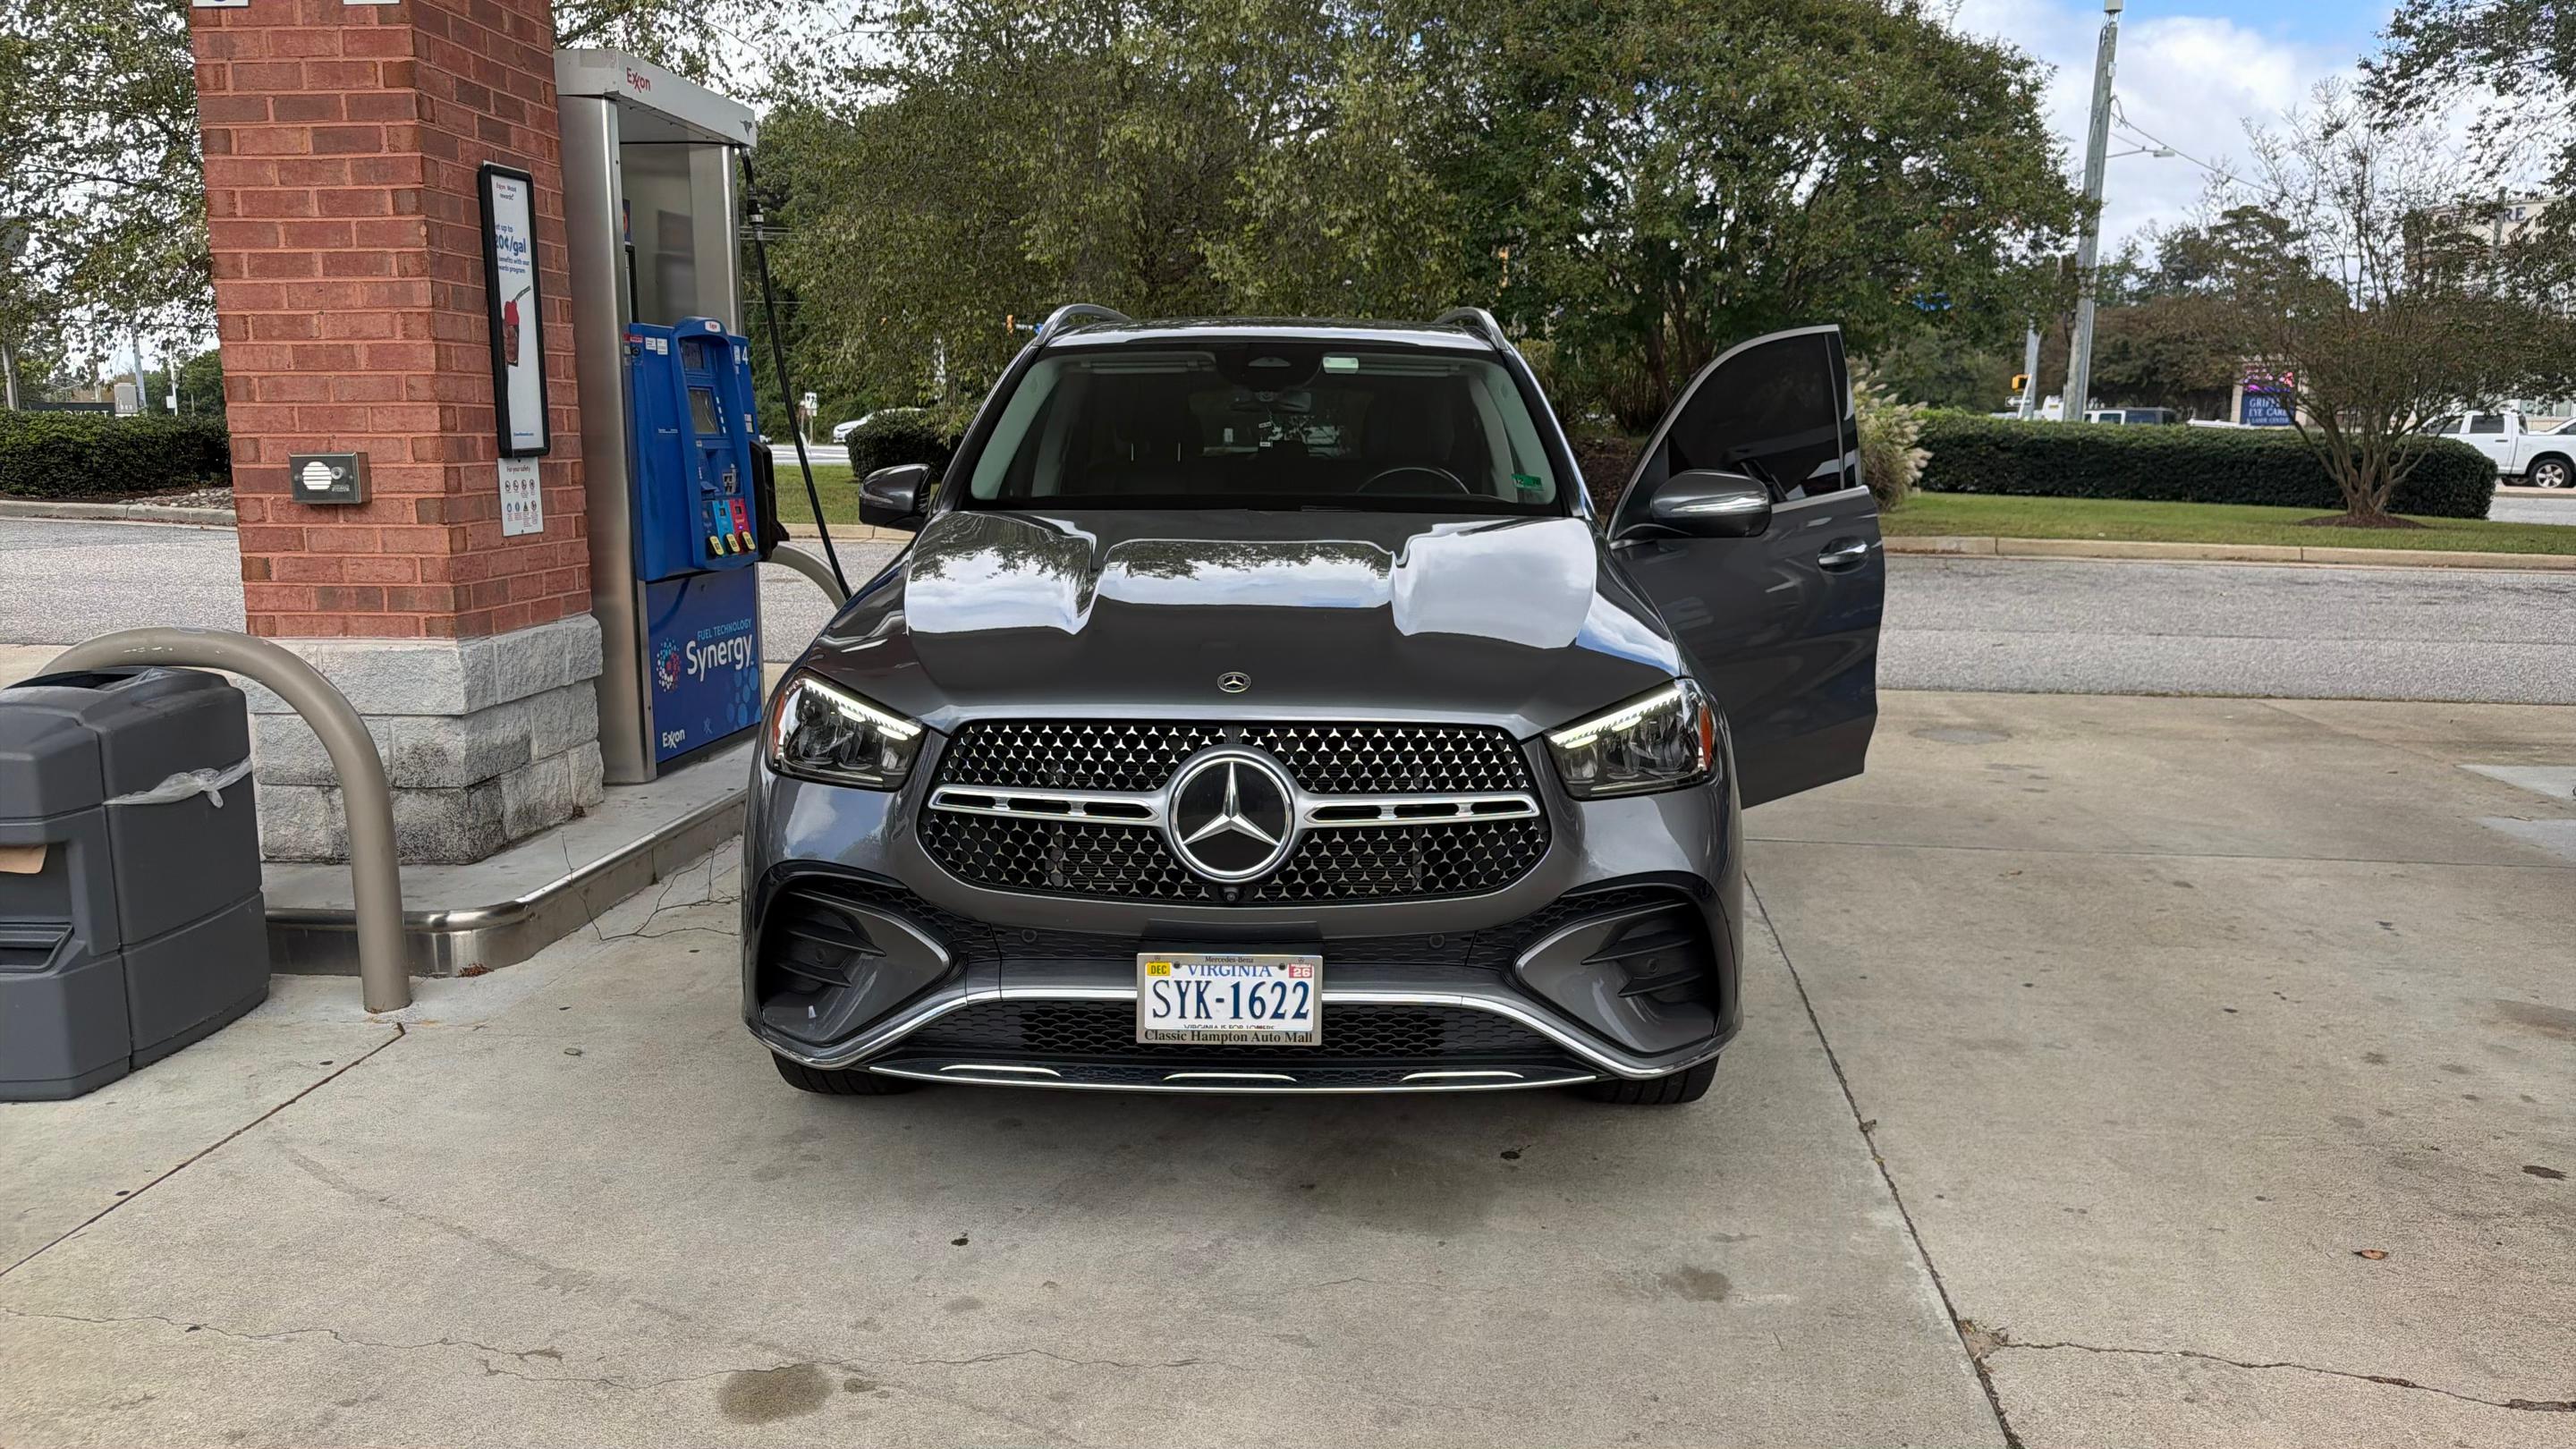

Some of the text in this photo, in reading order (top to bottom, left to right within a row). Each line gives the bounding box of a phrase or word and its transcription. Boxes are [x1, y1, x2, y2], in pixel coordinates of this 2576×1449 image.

[627, 66, 651, 93] Exxon
[508, 225, 513, 233] to
[741, 345, 749, 365] 4
[697, 618, 752, 641] FUEL TECHNOLOGY
[686, 633, 753, 682] Synergy
[662, 728, 686, 750] Exxon
[1150, 964, 1311, 978] DEC VIRGINIA 26
[1153, 979, 1309, 1020] SYK-1622
[1144, 1029, 1313, 1045] Classic Hampton Auto Mall
